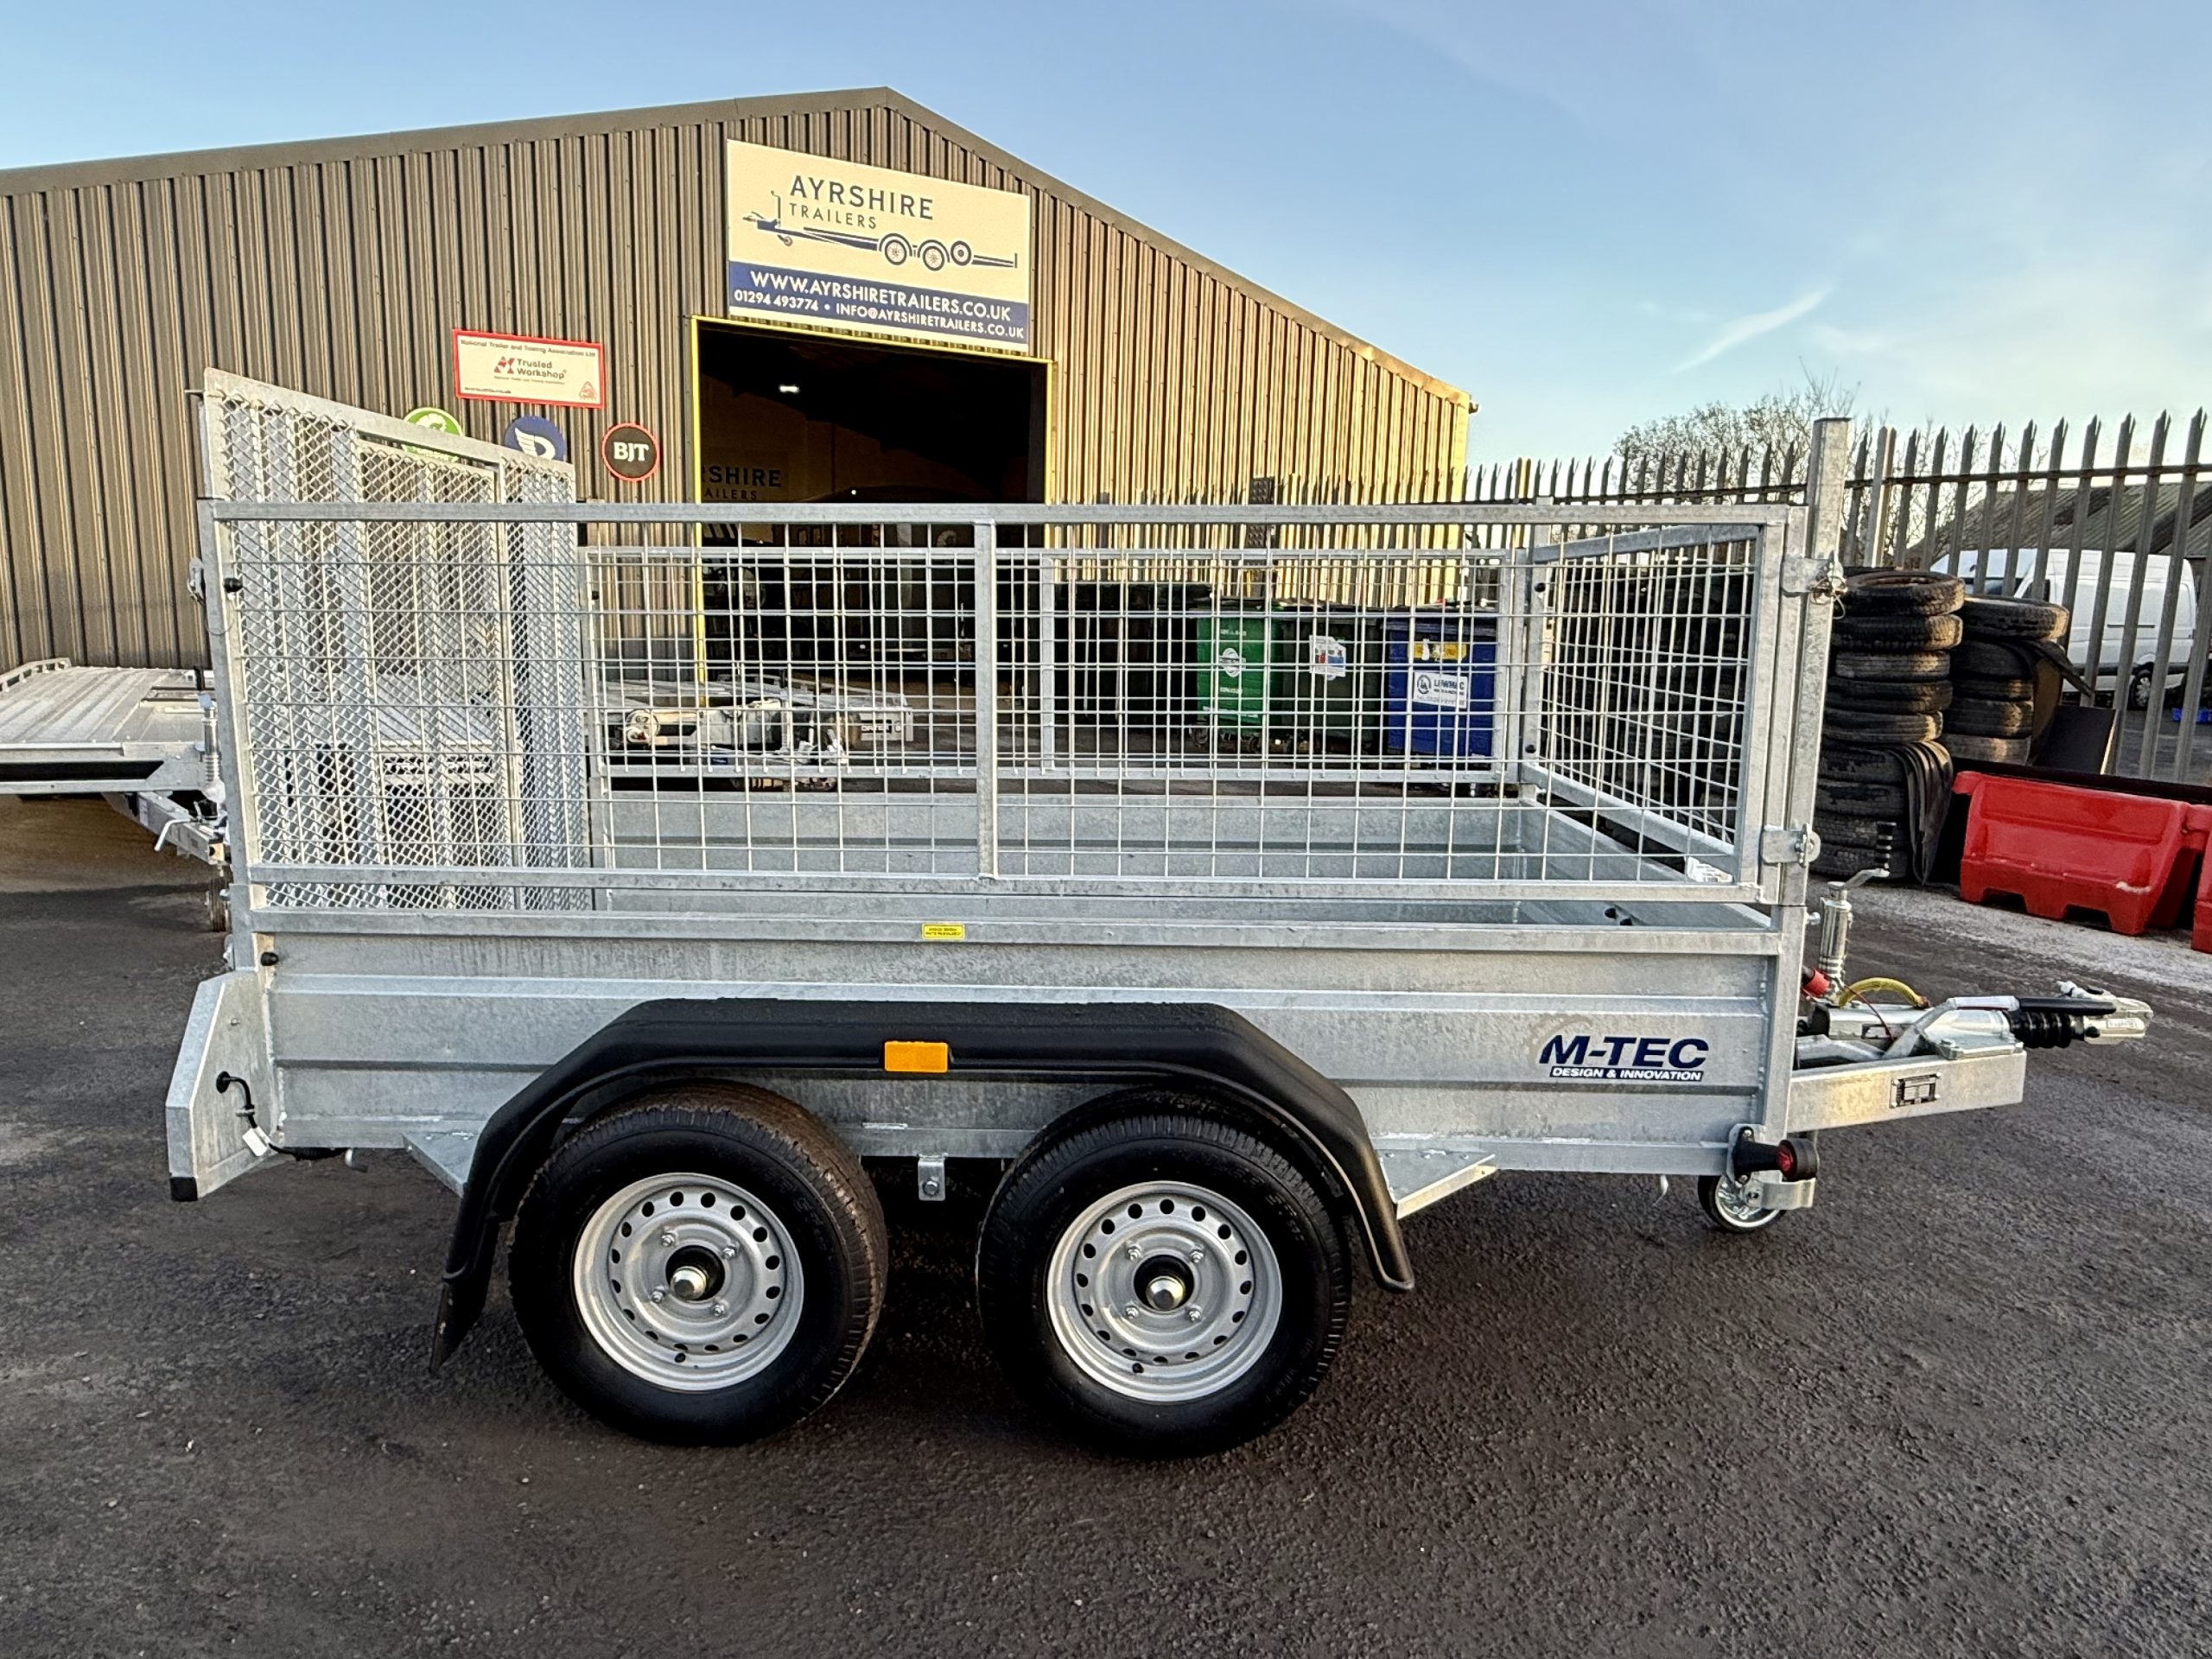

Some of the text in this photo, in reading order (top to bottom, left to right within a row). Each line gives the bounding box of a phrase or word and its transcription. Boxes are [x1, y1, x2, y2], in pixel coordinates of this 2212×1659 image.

[790, 175, 933, 220] AYRSHIRE
[789, 202, 877, 230] TRAILERS
[750, 270, 1011, 321] WWW.AYRSHIRETRAILERS.CO.UK
[734, 289, 1024, 339] 01294 493774 INFO@AYRSHIRETRAILERS.CO.UK
[517, 358, 553, 369] Trusted
[613, 442, 650, 462] BJT
[1539, 1034, 1710, 1069] M-TEC
[1552, 1067, 1702, 1081] DESIGN & INNOVATION
